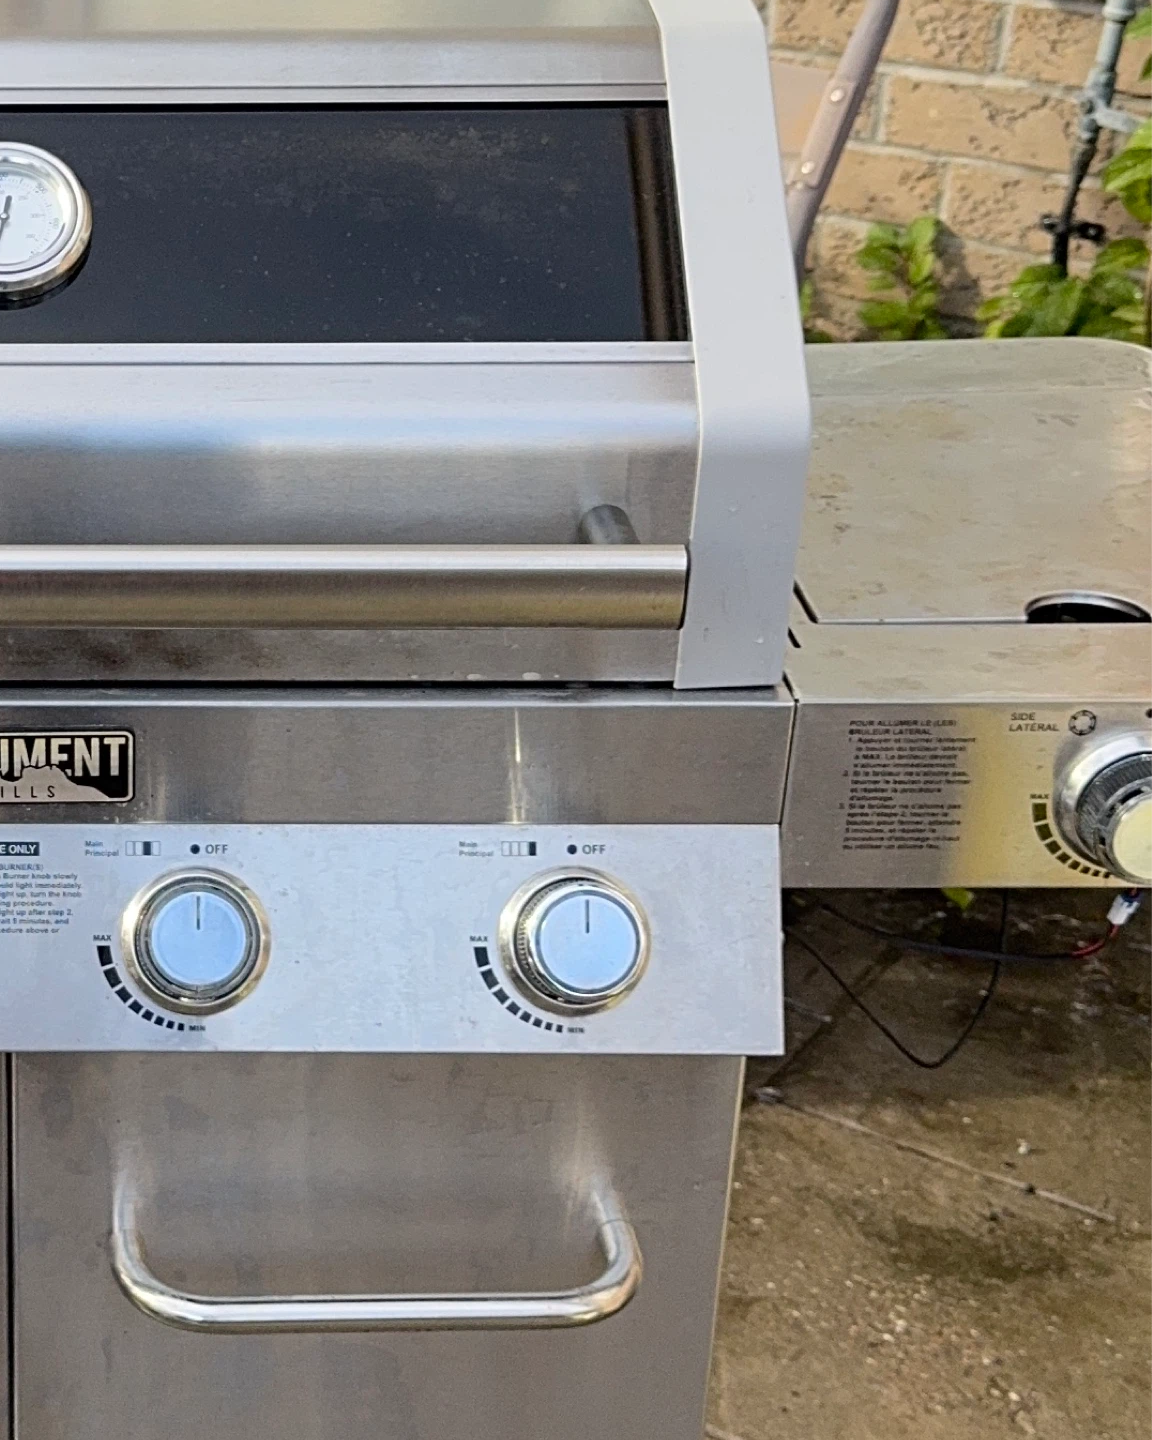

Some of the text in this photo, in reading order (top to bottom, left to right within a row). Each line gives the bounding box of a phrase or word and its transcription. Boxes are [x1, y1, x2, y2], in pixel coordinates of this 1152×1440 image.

[8, 845, 37, 854] ONLY
[205, 844, 228, 854] OFF
[582, 845, 605, 854] OFF
